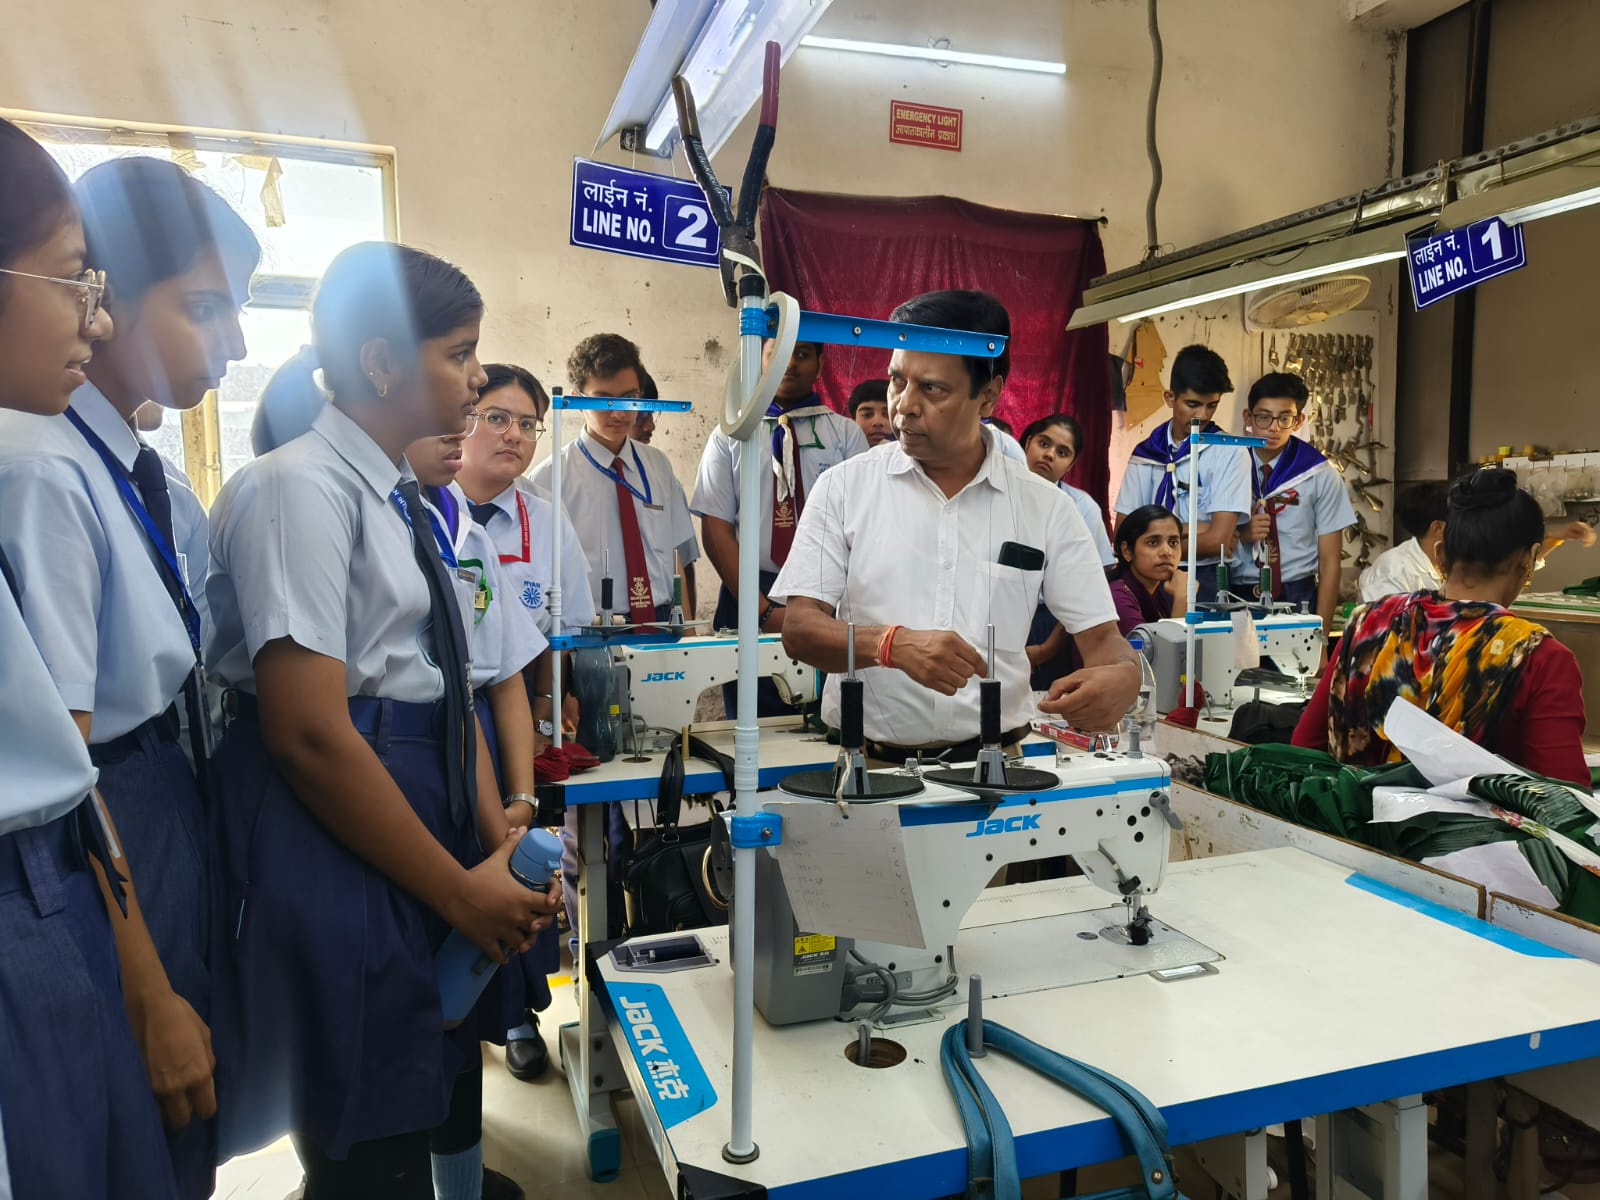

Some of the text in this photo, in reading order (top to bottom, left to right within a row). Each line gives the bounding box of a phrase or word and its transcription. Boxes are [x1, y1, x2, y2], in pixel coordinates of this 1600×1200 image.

[896, 109, 957, 127] EMERGENCY LIGHT
[581, 179, 629, 208] लाईन
[582, 204, 708, 249] LINE NO. 2
[1412, 237, 1443, 266] लाईन
[1418, 220, 1503, 294] LINE NO. 1
[965, 813, 1042, 838] JACK
